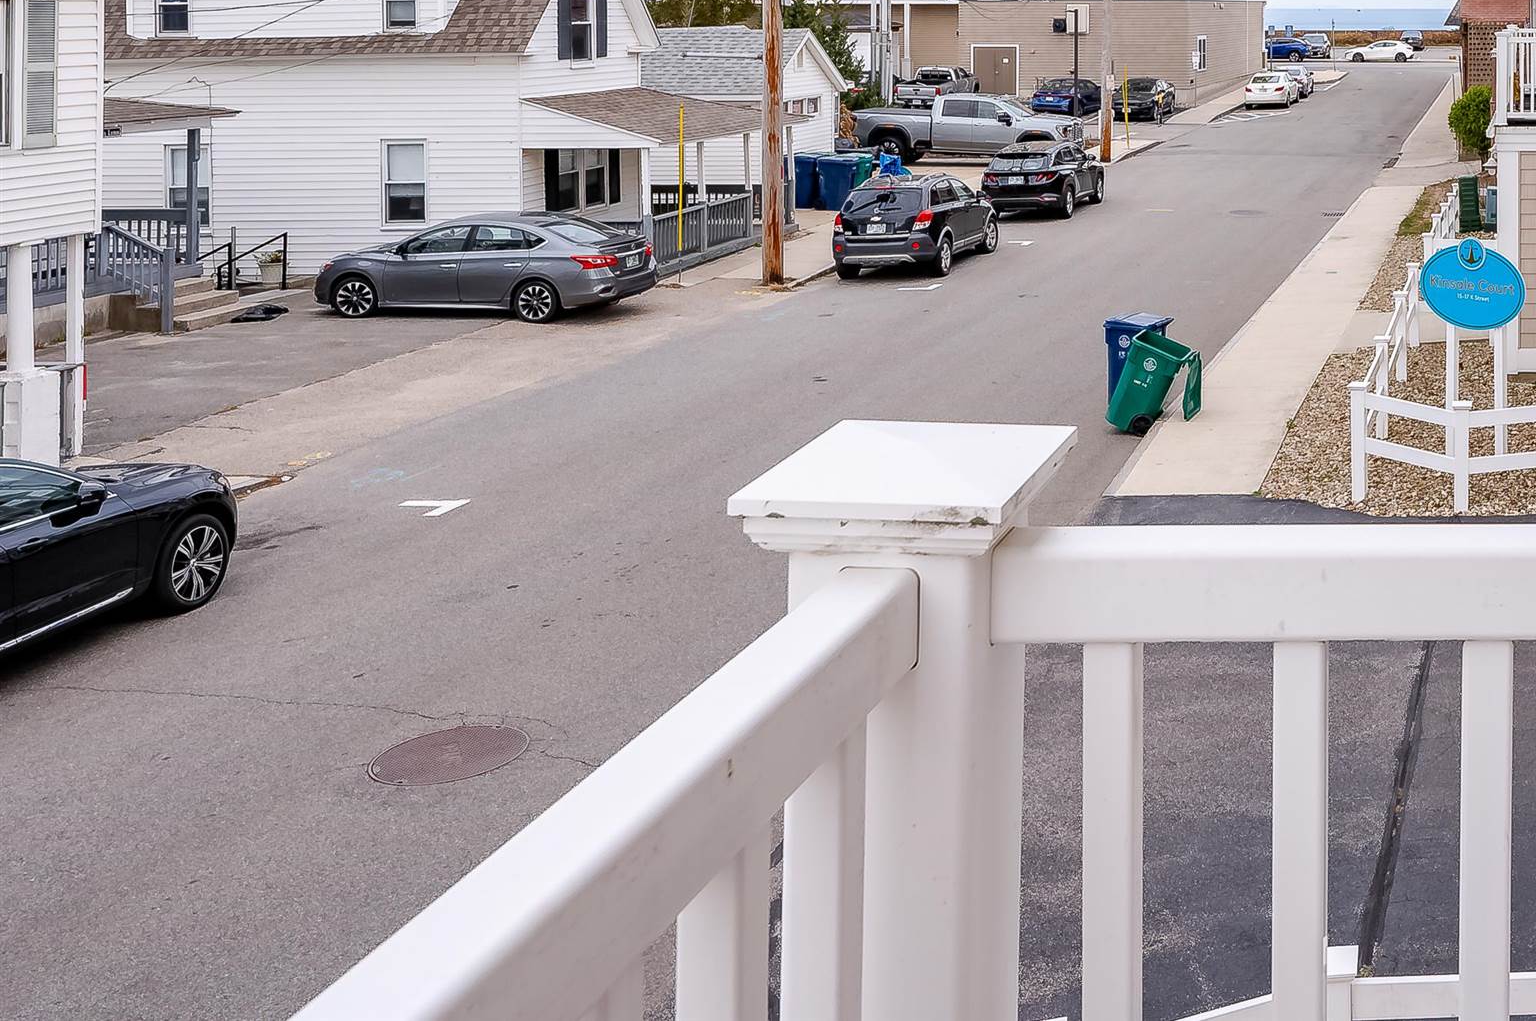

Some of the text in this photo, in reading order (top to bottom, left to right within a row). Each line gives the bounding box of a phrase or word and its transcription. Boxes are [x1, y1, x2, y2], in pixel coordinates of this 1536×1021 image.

[1430, 274, 1514, 296] Kinsale Court
[1474, 295, 1490, 303] Street
